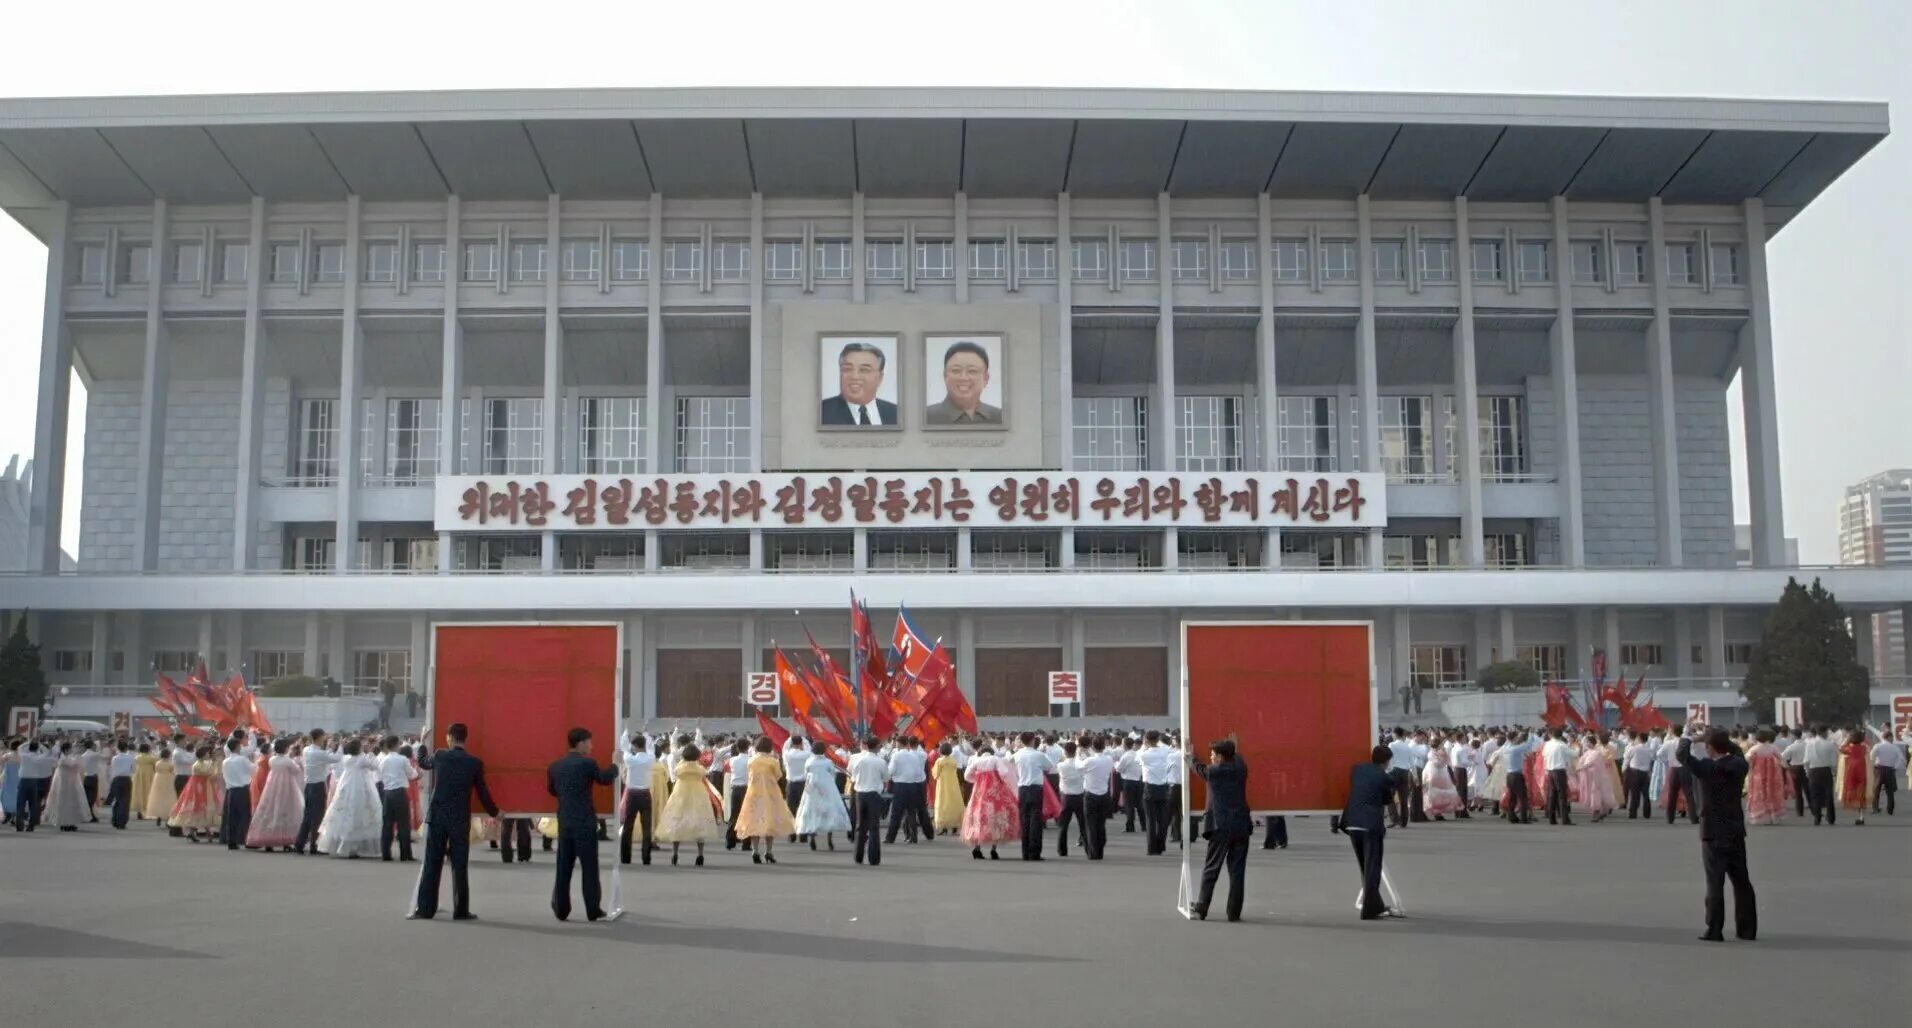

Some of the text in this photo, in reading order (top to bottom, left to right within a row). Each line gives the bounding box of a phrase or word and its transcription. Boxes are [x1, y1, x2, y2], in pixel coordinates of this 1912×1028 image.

[458, 476, 1367, 527] 위대한 김일성동지와 김정일동지는 영원히 우리와 함께 계신다
[752, 674, 776, 703] 경
[1053, 673, 1078, 701] 축
